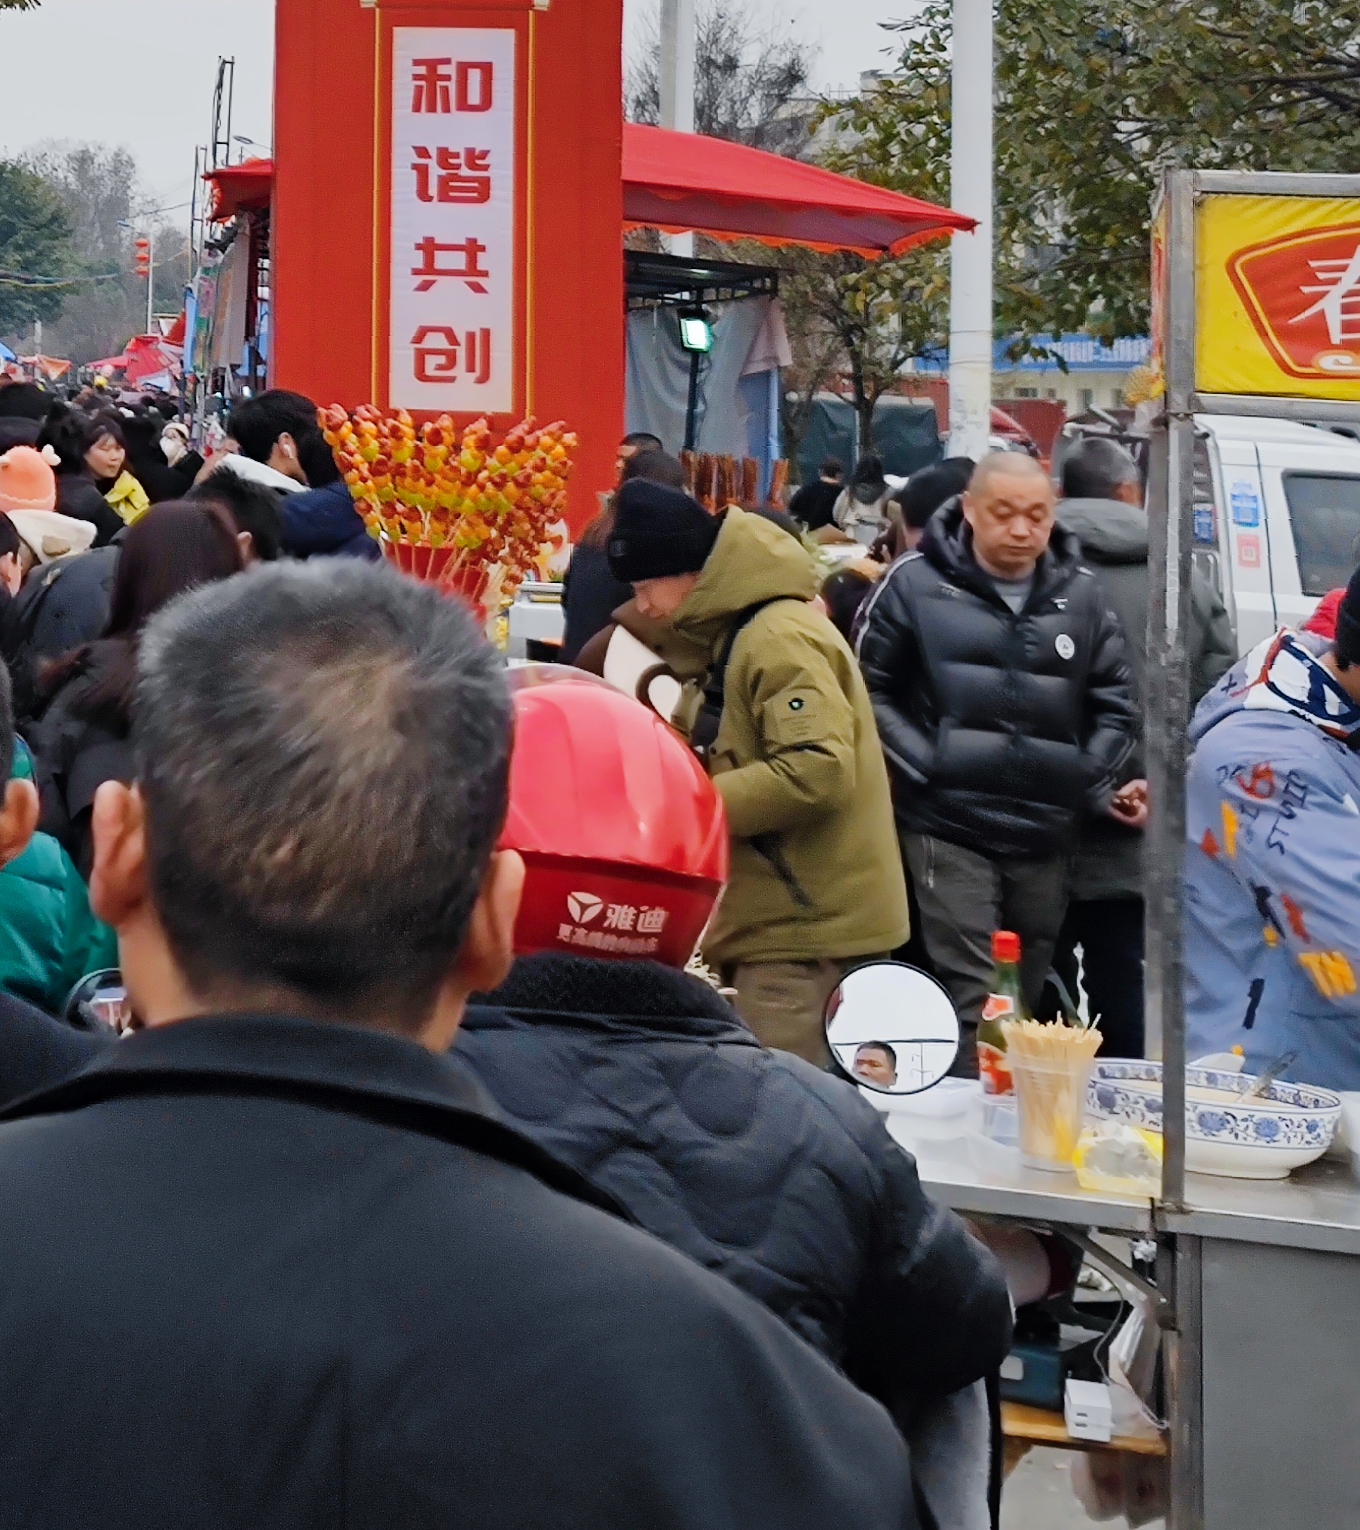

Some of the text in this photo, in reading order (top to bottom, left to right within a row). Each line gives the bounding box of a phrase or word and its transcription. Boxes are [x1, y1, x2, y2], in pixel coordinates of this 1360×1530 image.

[411, 57, 493, 384] 和谐共创
[603, 903, 669, 933] 雅迪
